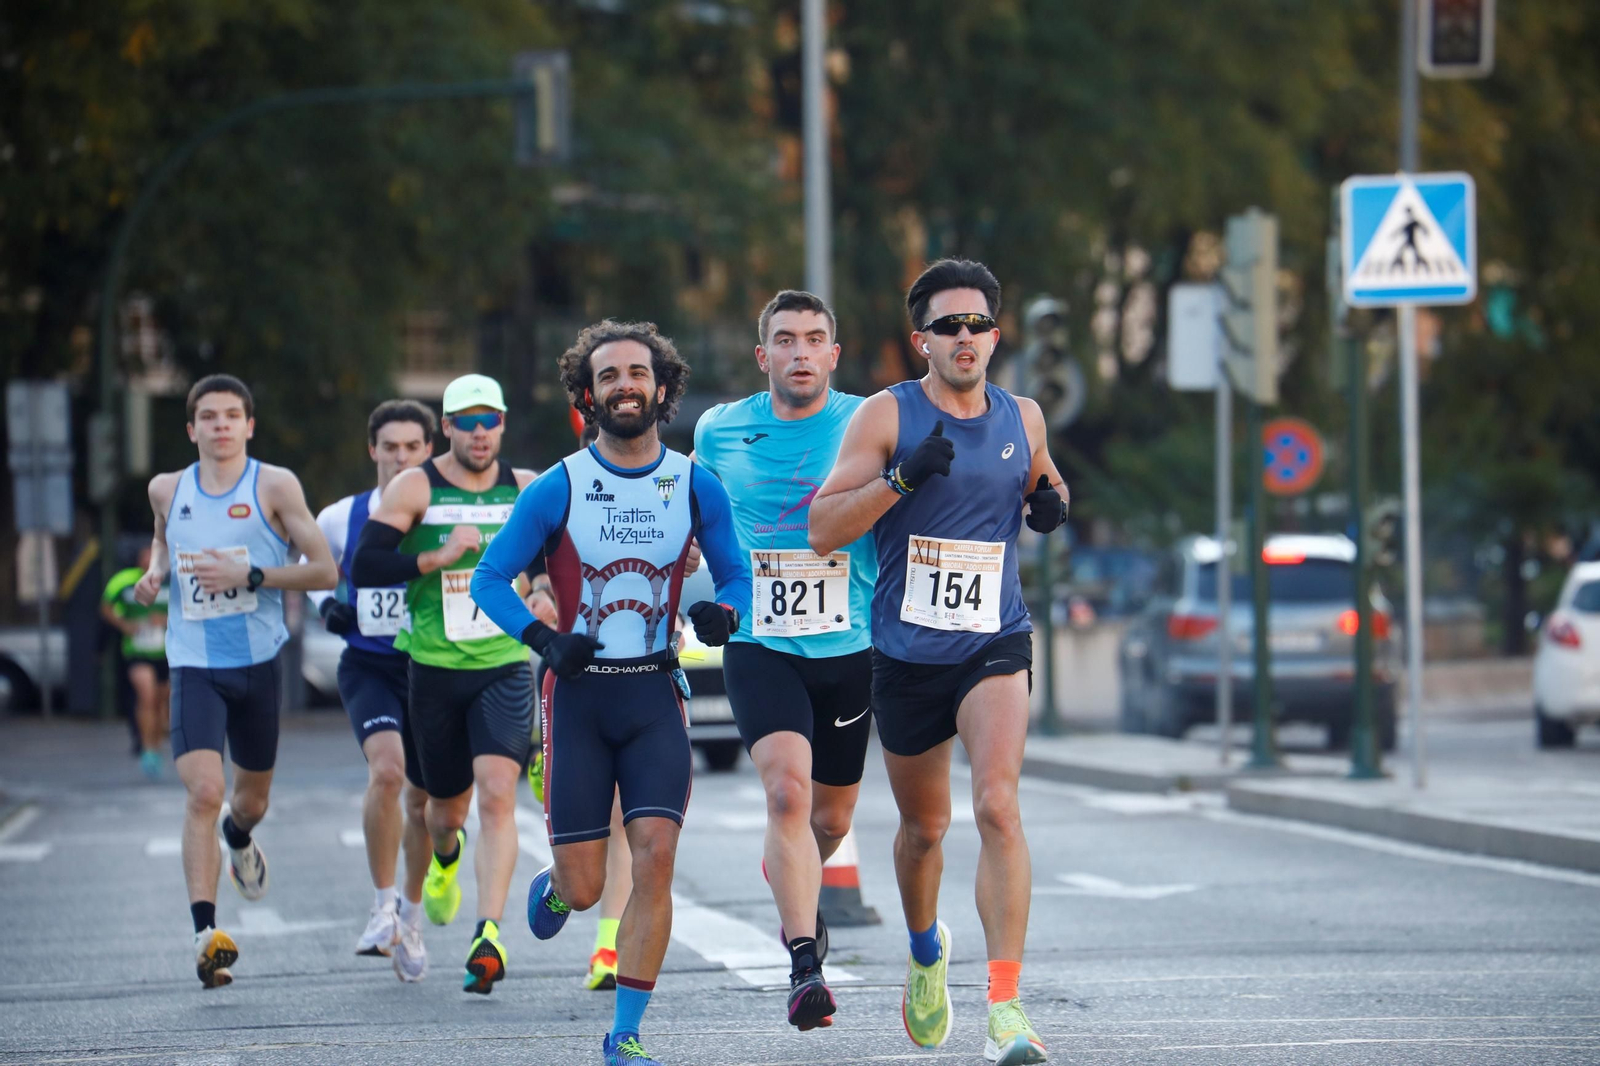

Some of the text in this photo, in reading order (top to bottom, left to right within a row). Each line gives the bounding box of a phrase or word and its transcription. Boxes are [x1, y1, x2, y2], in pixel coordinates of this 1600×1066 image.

[585, 493, 615, 502] VIATOR
[602, 507, 656, 524] Triatlon
[912, 539, 942, 567] XLI
[953, 544, 974, 552] CARRERA
[754, 553, 781, 577] XLI
[445, 573, 468, 594] XLI
[929, 570, 982, 611] 154
[771, 579, 825, 616] 821
[584, 664, 659, 674] VELOCHAMPION
